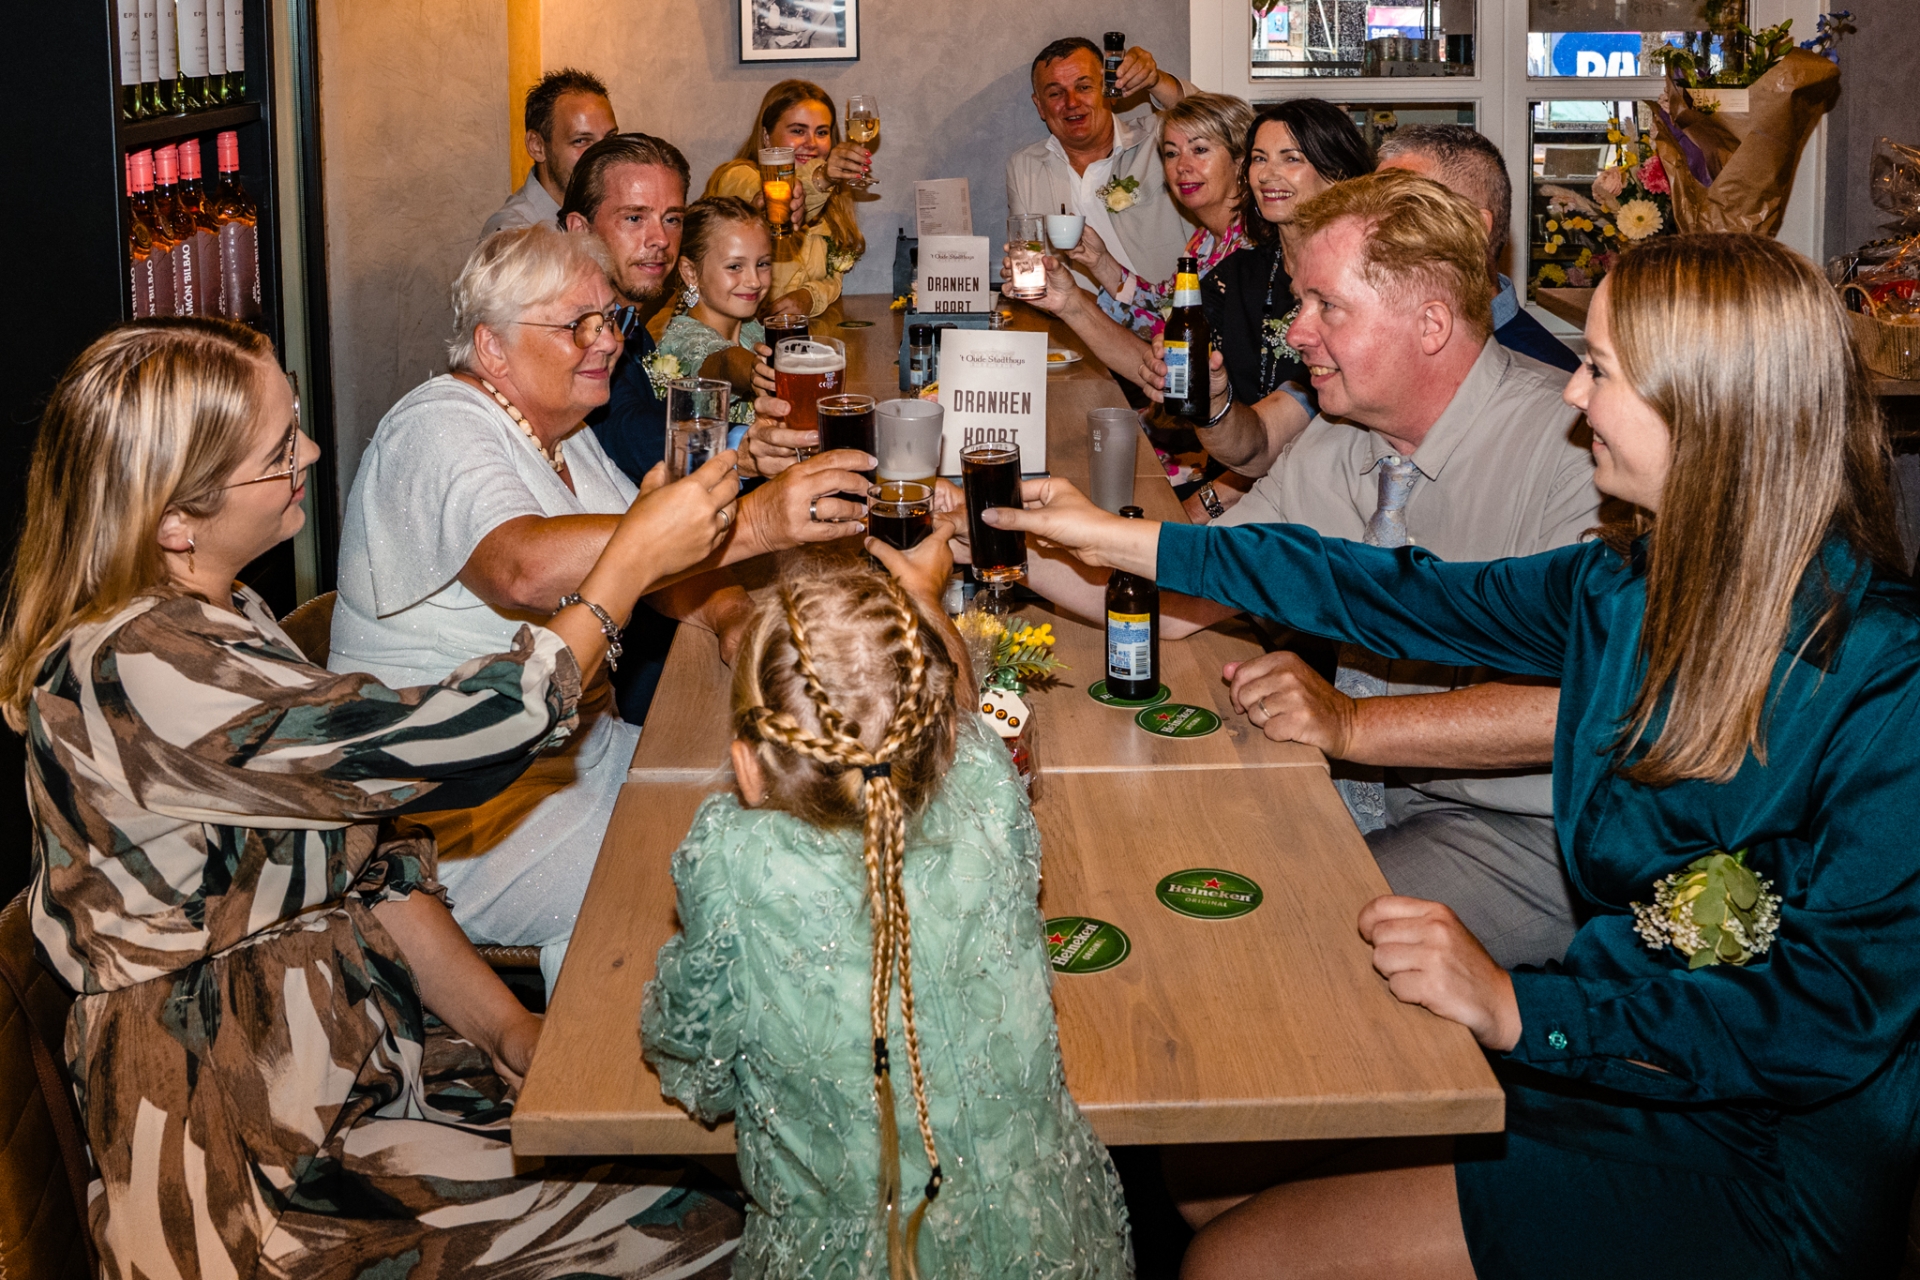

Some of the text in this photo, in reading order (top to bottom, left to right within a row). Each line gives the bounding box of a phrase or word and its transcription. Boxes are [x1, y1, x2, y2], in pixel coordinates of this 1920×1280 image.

[1576, 50, 1640, 77] DA
[146, 260, 155, 302] BILBAO
[182, 244, 194, 316] AMÓN BILBAO
[927, 276, 979, 292] DRANKEN
[935, 300, 972, 312] KAART
[966, 354, 986, 362] Oude
[954, 390, 1032, 414] DRANKEN
[964, 427, 1018, 446] KAART
[1168, 883, 1252, 902] Heineken
[1184, 897, 1228, 908] ORIGINAL
[1051, 923, 1099, 966] Heineken
